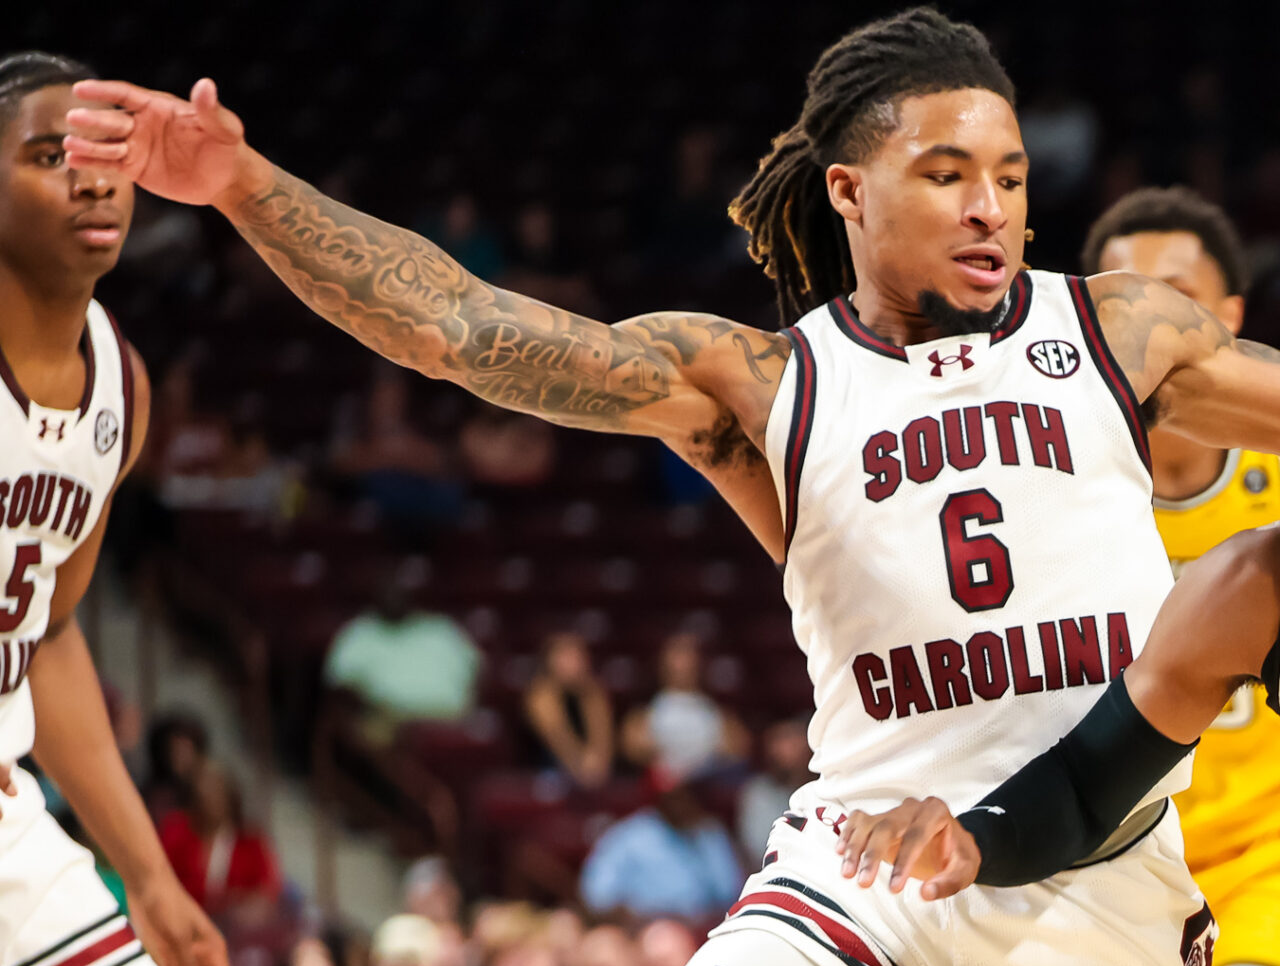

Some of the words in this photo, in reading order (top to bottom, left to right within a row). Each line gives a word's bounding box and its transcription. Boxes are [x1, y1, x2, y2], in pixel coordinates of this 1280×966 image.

[472, 322, 583, 372] Beat
[1030, 341, 1078, 375] SEC
[862, 401, 1075, 503] SOUTH
[939, 487, 1015, 613] 6
[852, 612, 1135, 722] CAROLINA
